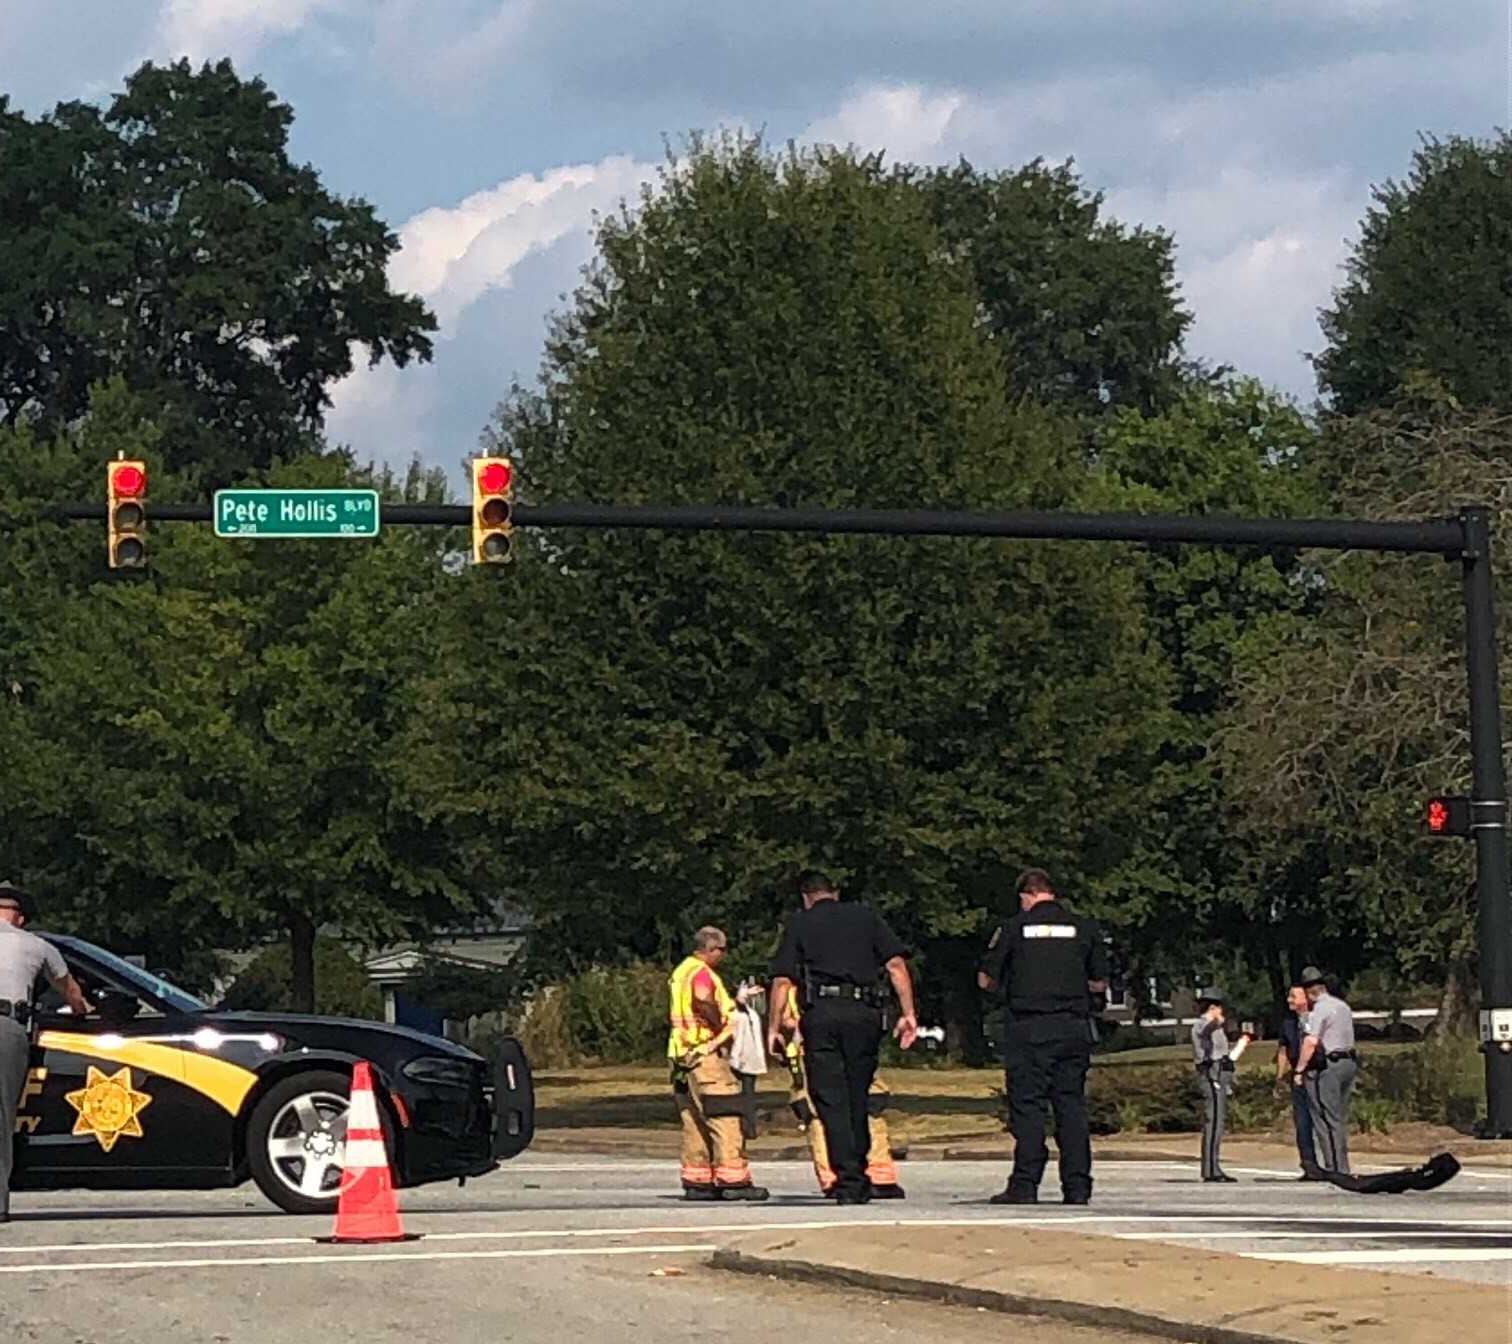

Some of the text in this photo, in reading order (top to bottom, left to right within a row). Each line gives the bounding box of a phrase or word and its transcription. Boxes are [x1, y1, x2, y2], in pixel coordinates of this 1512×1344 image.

[222, 499, 372, 522] Pete Hollis BLVD
